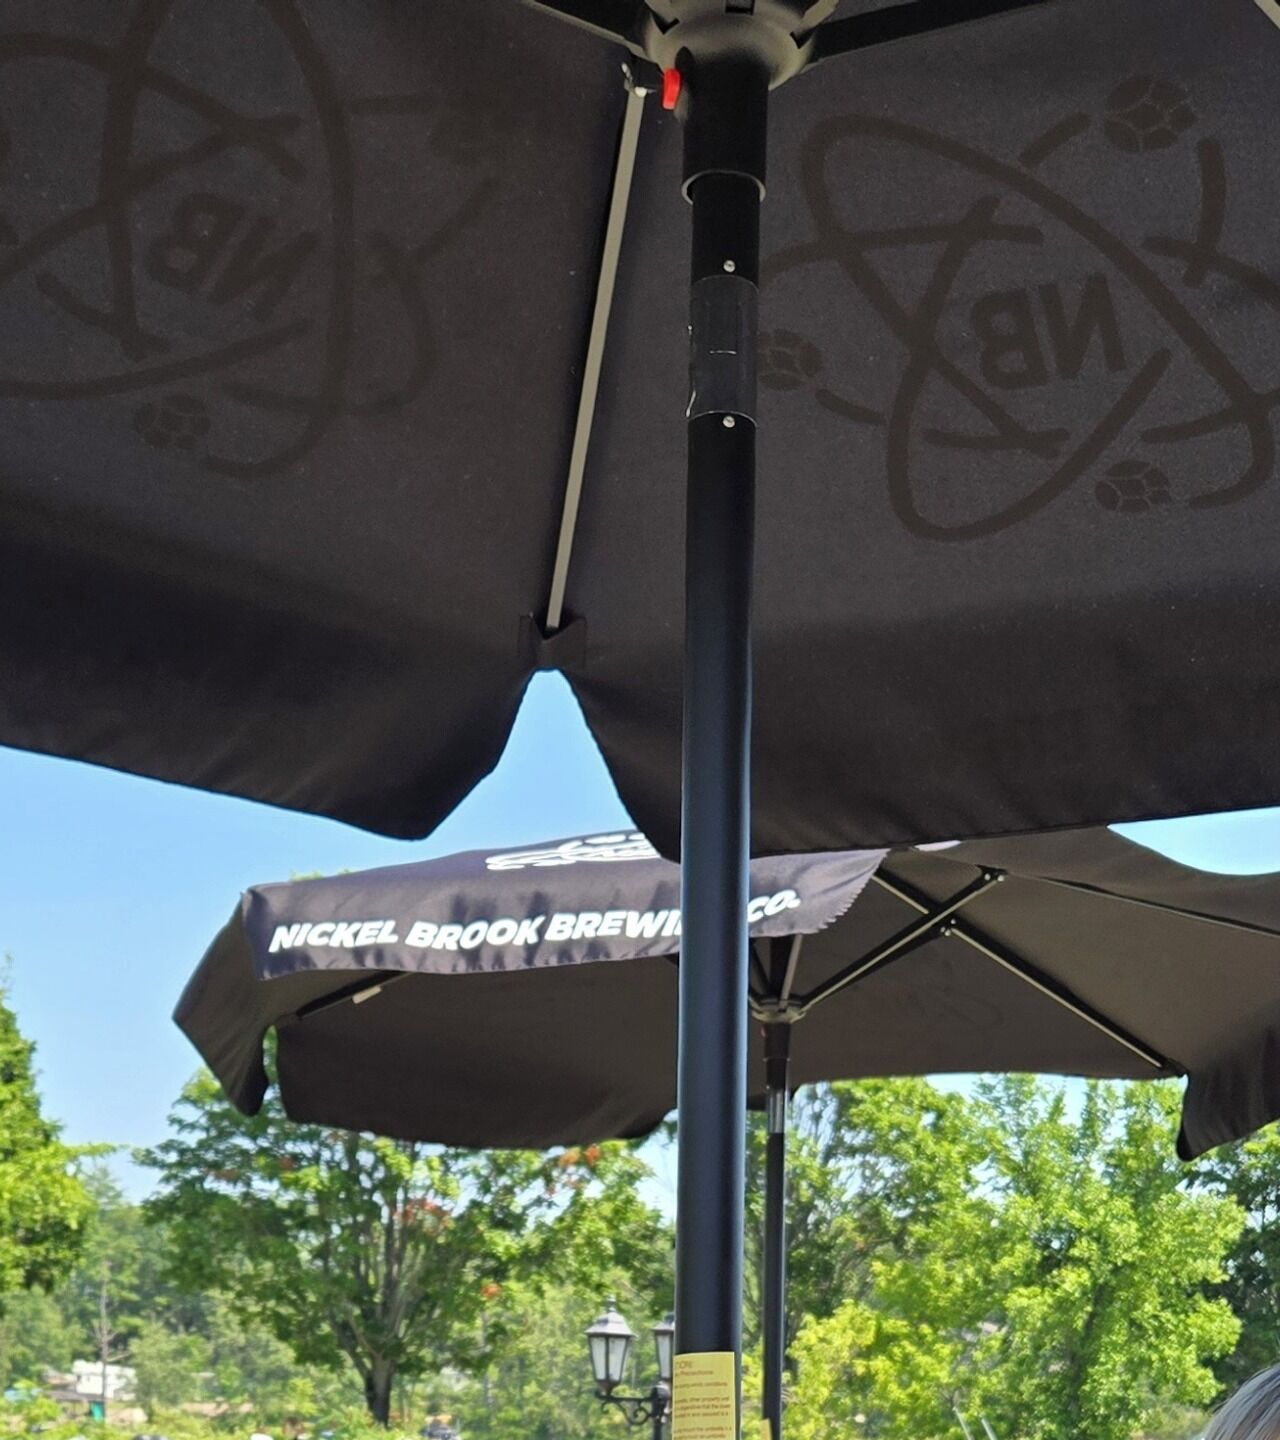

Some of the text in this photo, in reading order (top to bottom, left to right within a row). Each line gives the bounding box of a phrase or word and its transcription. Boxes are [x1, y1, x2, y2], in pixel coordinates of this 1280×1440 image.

[269, 919, 399, 953] NICKEL
[405, 915, 545, 950] BROOK
[544, 909, 682, 941] BREWI
